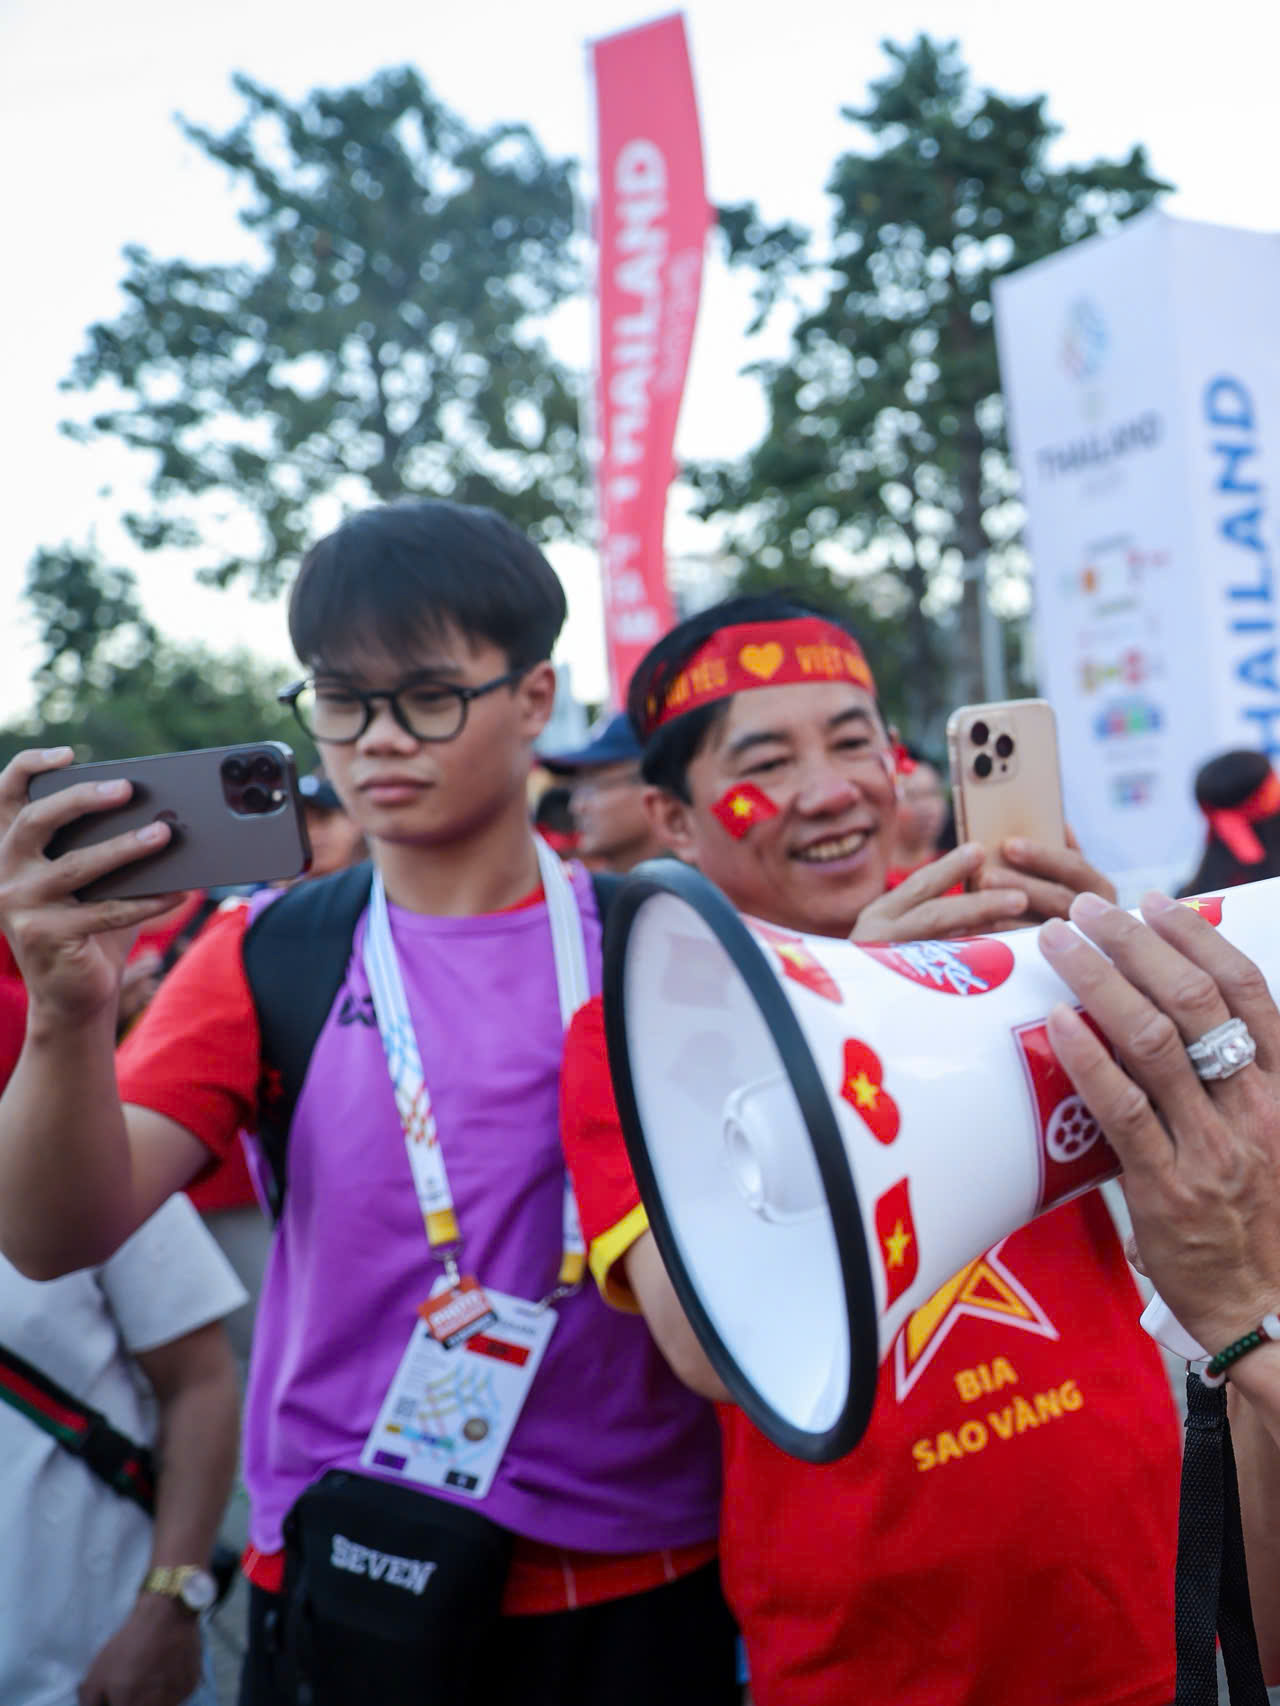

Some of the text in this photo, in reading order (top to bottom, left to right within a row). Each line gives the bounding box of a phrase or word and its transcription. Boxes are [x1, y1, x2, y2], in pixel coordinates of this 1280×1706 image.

[954, 1355, 1019, 1402] BIA
[911, 1378, 1084, 1472] SAO VÀNG
[330, 1533, 437, 1596] SEVEN
